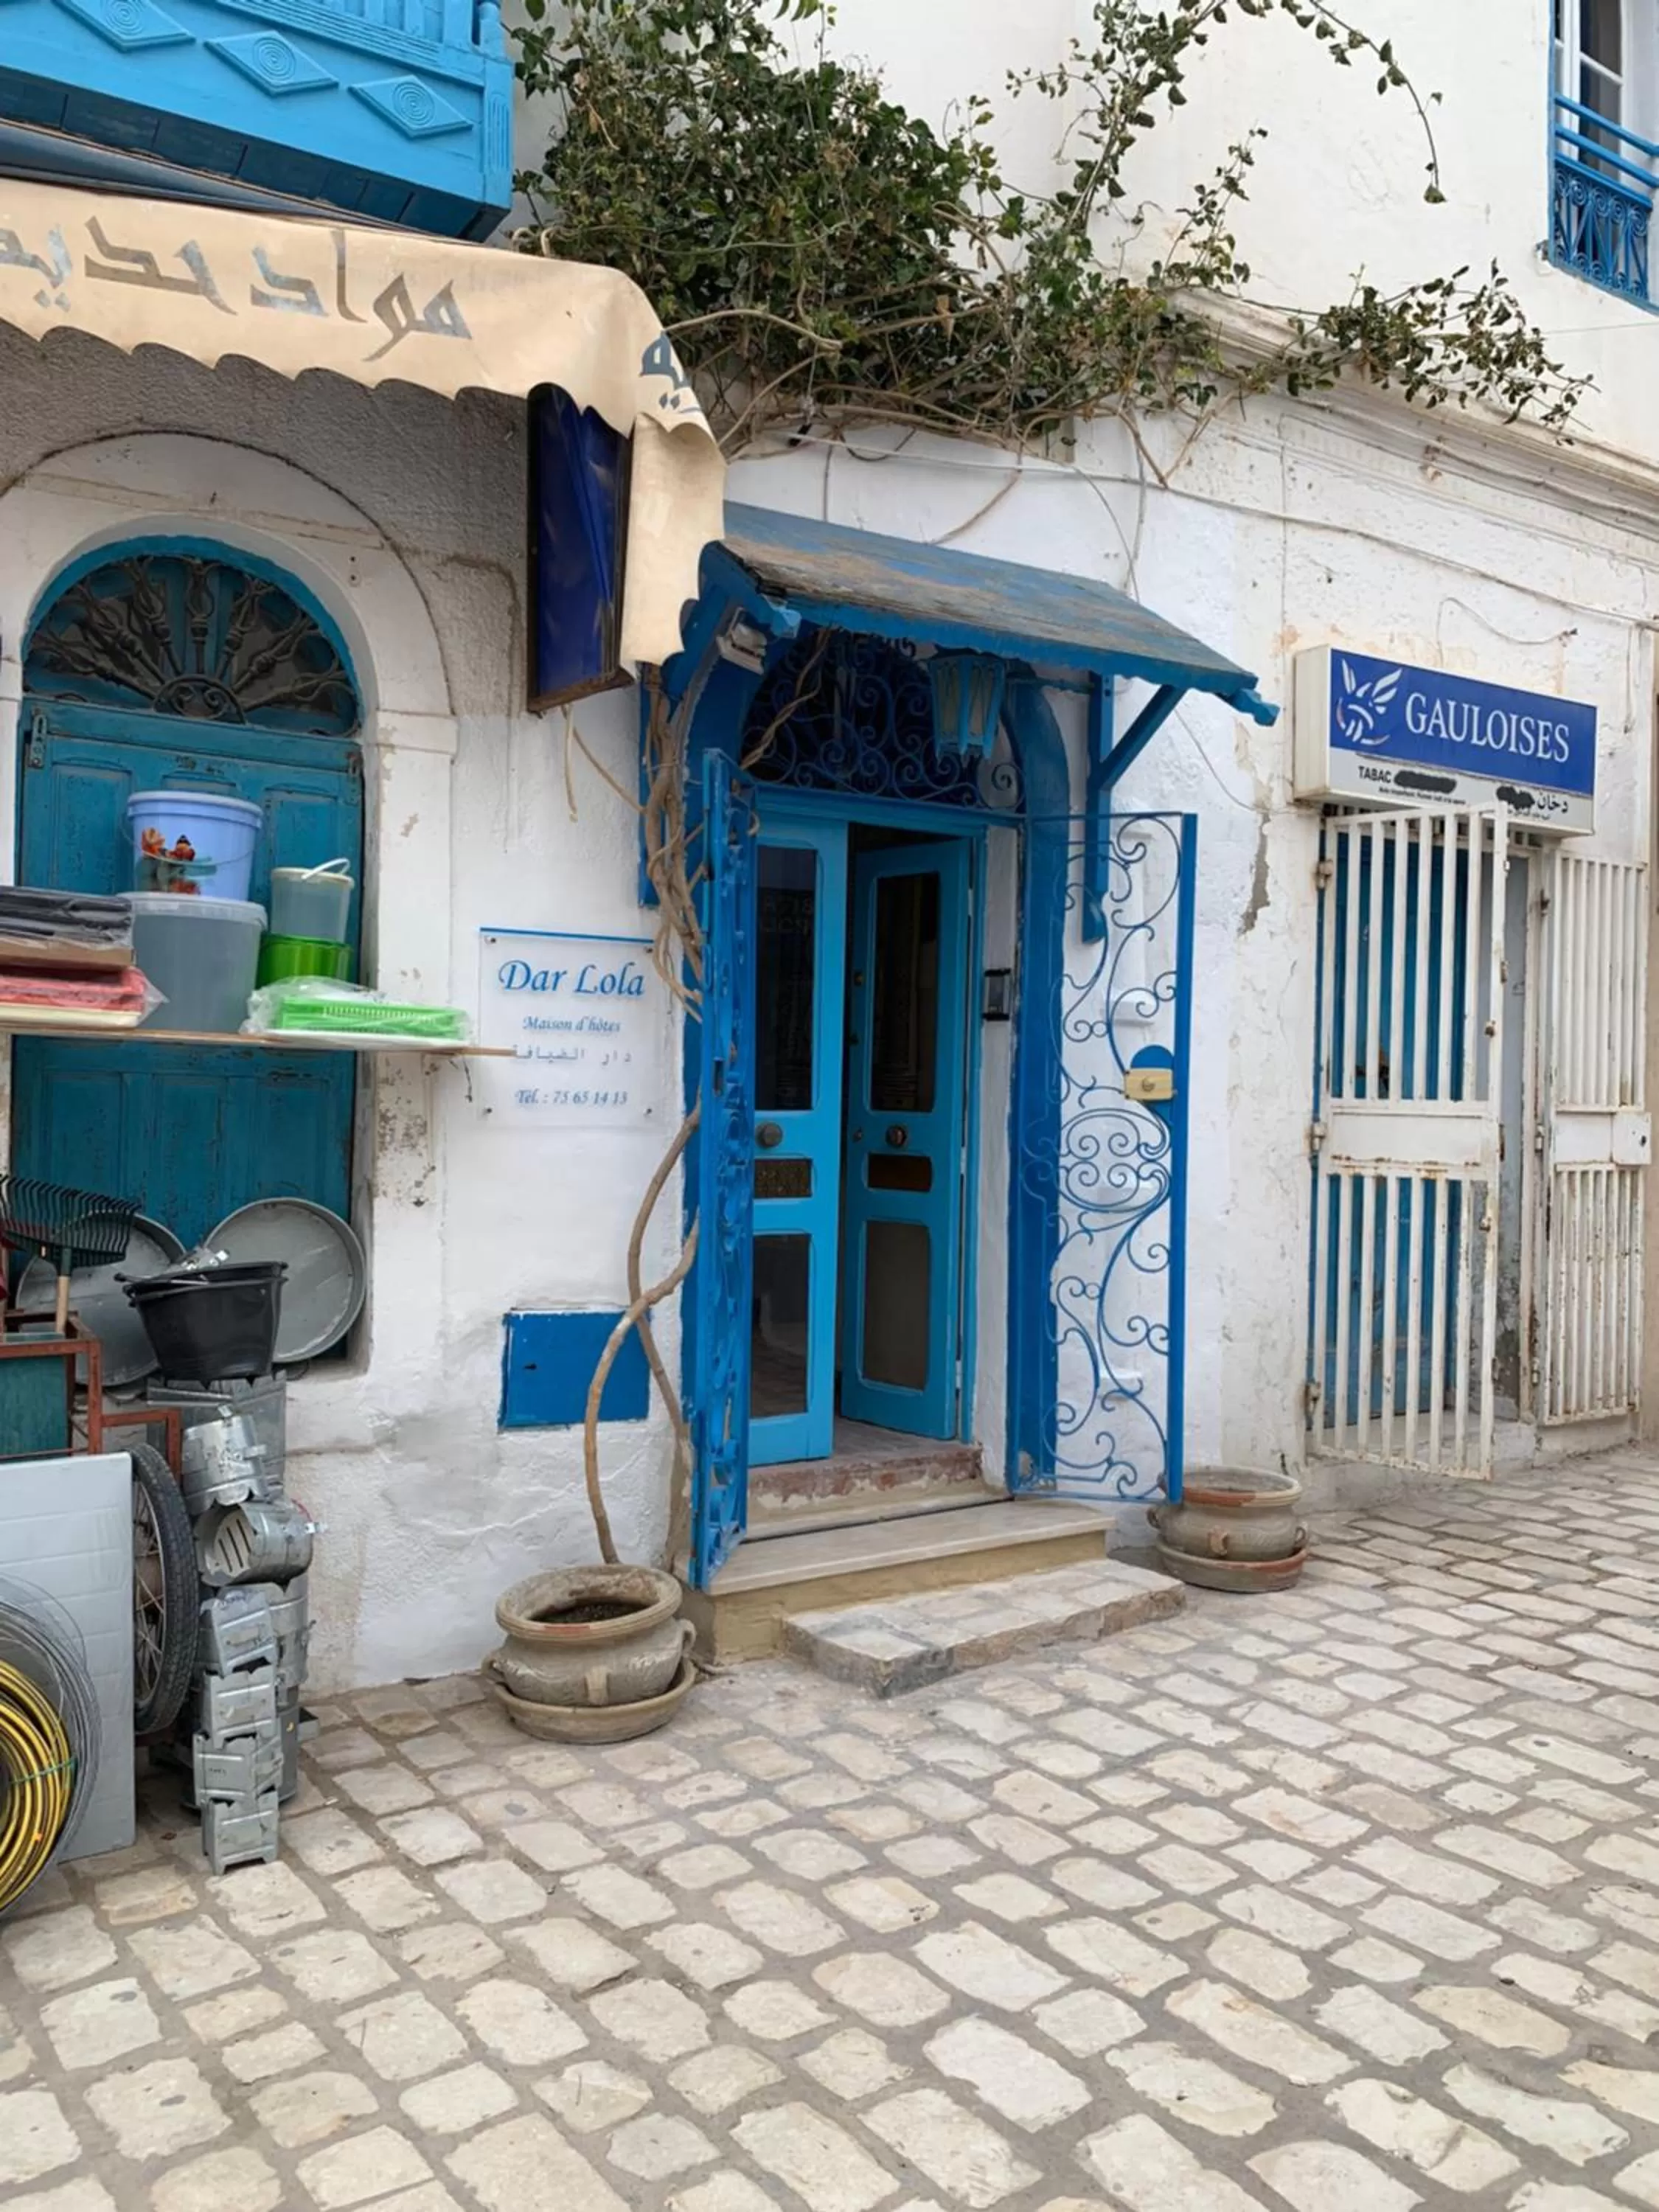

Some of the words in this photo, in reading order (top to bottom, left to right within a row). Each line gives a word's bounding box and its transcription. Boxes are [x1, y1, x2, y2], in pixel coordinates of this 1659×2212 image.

[251, 229, 473, 362] مواد
[1405, 692, 1570, 763] GAULOISES
[1358, 765, 1391, 784] TABAC
[1537, 790, 1568, 813] دخان
[498, 960, 567, 992] Dar
[574, 961, 645, 995] Lola
[523, 1016, 572, 1030] Maison
[594, 1091, 609, 1105] 14
